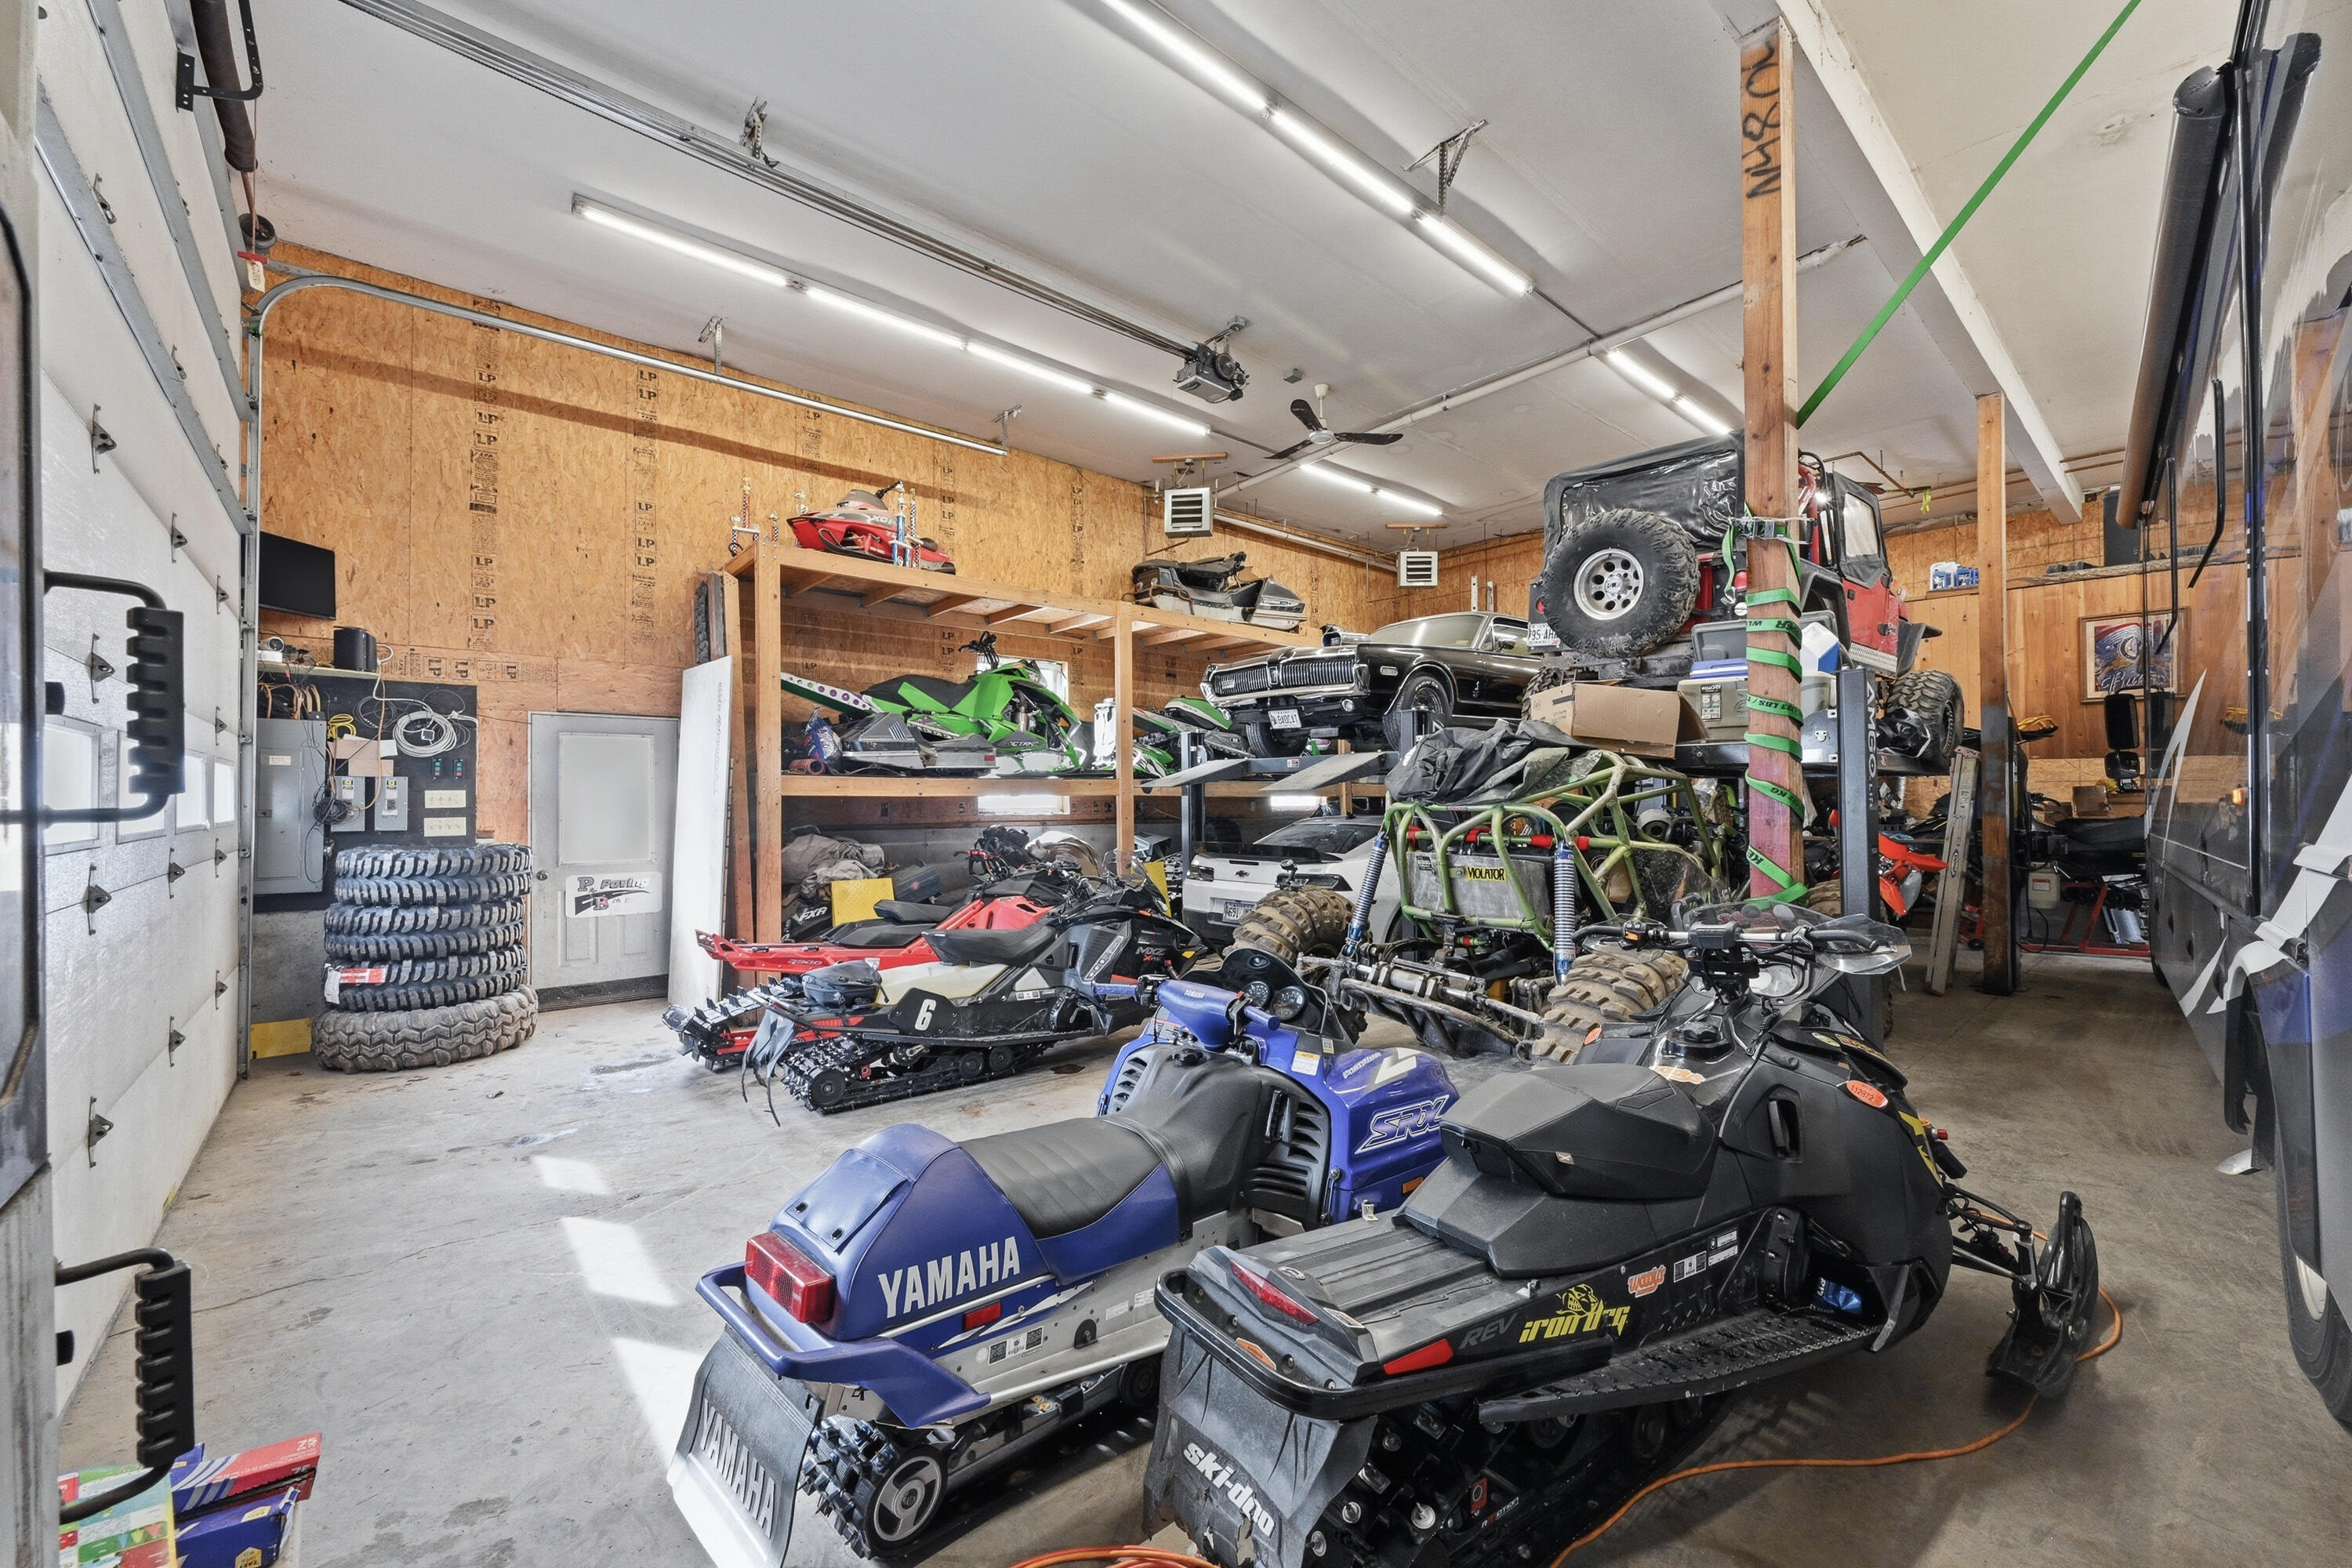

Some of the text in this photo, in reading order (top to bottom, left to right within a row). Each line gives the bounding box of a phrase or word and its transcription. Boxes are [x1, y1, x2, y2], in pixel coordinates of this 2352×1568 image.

[1867, 681, 1877, 779] AMGO
[1467, 866, 1505, 881] VIOLATOR
[914, 998, 937, 1032] 6
[1354, 1094, 1450, 1155] SRX
[877, 1236, 1021, 1319] YAMAHA
[1458, 1312, 1519, 1350] REV
[700, 1397, 776, 1541] YAMAHA
